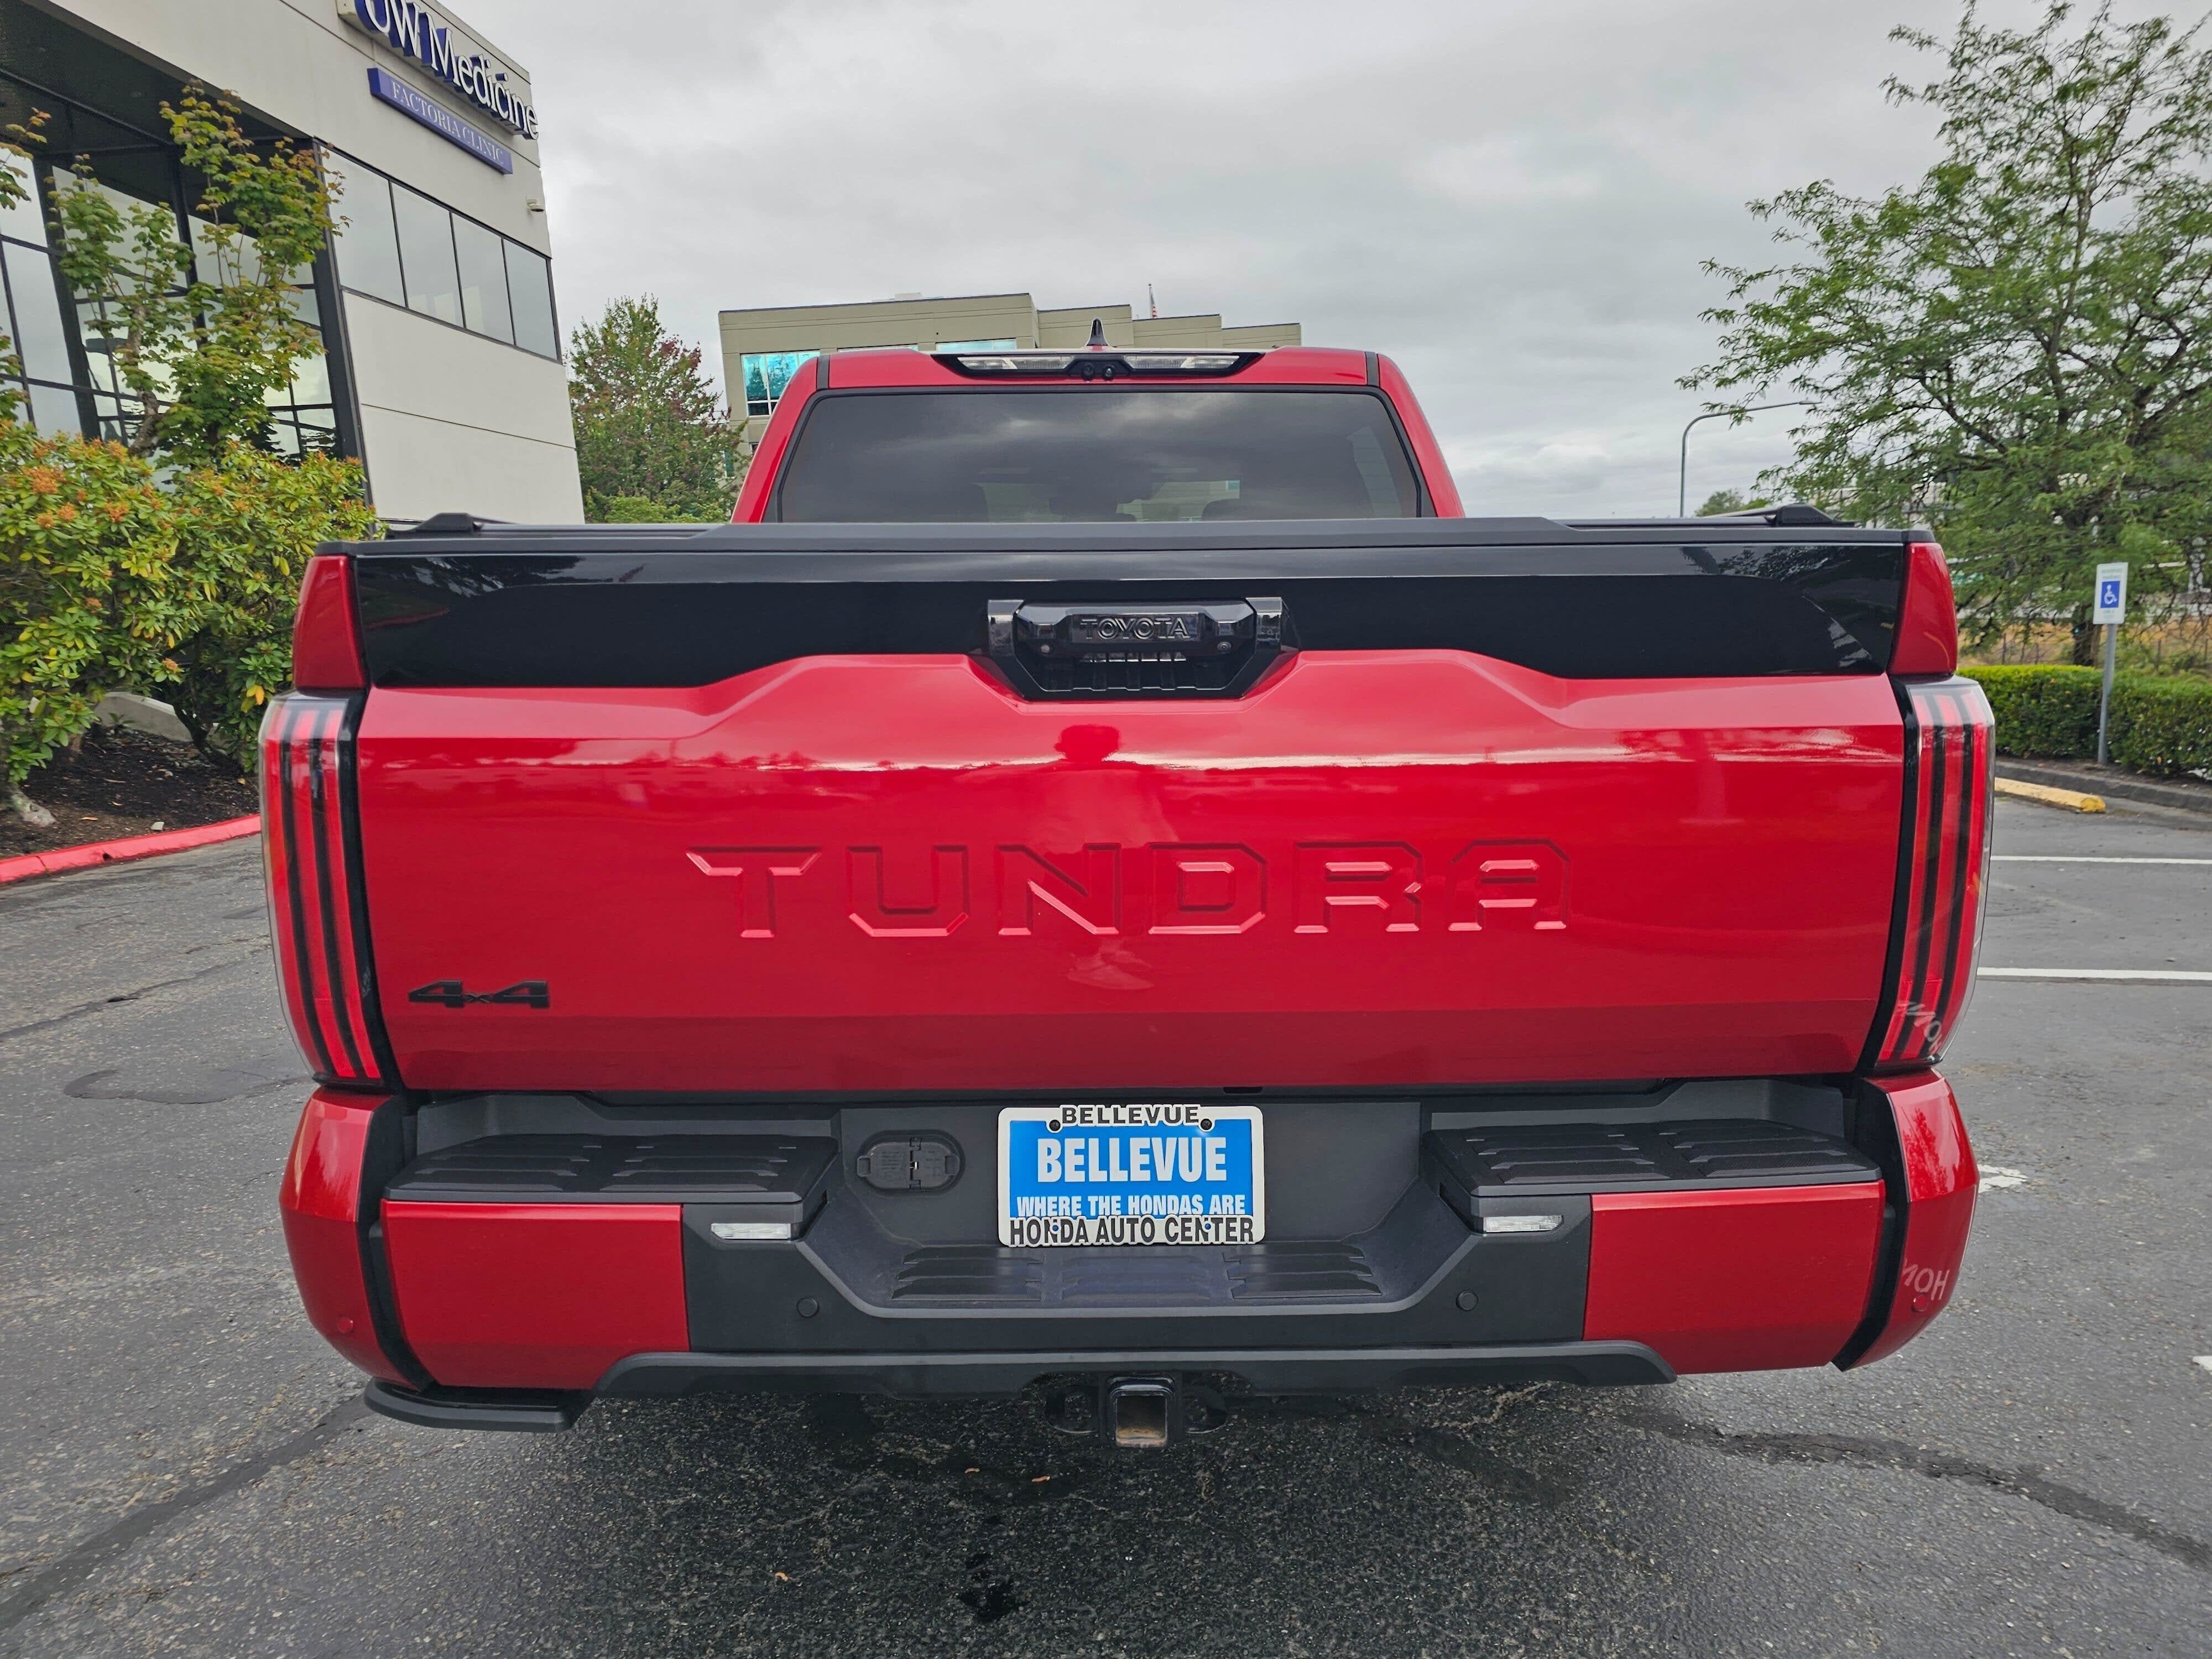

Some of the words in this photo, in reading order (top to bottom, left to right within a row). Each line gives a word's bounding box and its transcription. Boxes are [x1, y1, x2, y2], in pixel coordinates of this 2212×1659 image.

[425, 12, 539, 140] Medicine
[390, 81, 461, 138] FACTORIA
[462, 126, 504, 165] CLINIC
[1079, 617, 1191, 640] TOYOTA
[685, 838, 1571, 938] TUNDRA
[1061, 1106, 1199, 1125] BELLEVUE
[1037, 1136, 1227, 1183] BELLEVUE
[1016, 1196, 1082, 1217] WHERE
[1087, 1196, 1121, 1216] THE
[1128, 1194, 1203, 1215] HONDAS
[1209, 1194, 1245, 1215] ARE
[1009, 1218, 1086, 1245] HONDA
[1096, 1218, 1156, 1243] AUTO
[1164, 1217, 1254, 1243] CENTER
